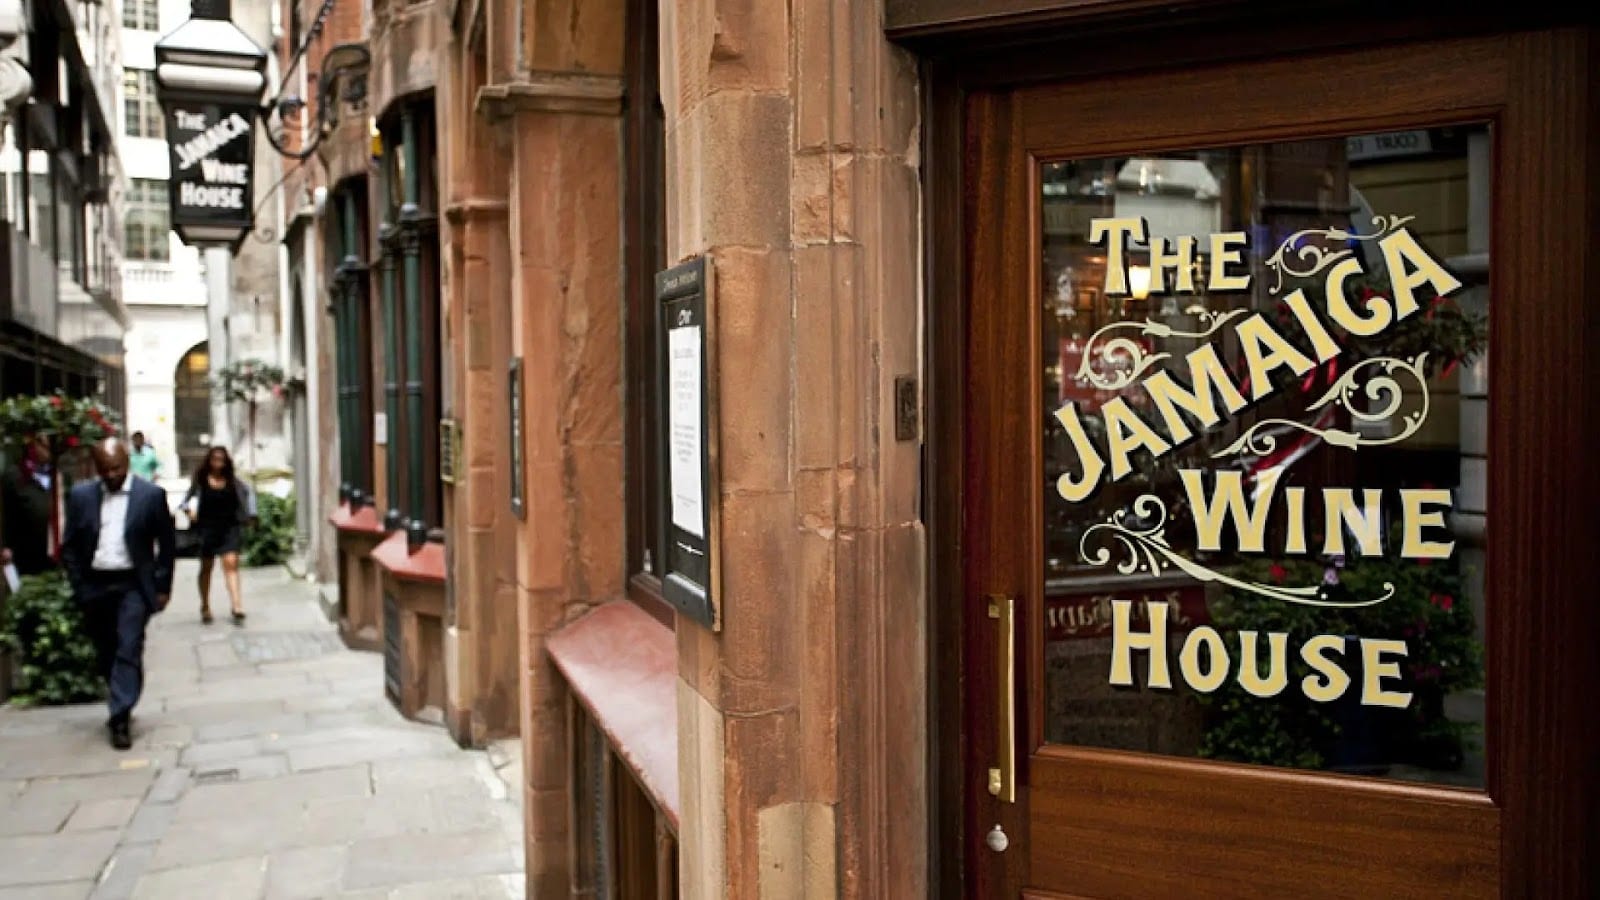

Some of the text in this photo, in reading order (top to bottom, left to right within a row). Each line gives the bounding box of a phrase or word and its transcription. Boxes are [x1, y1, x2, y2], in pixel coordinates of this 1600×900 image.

[175, 110, 206, 129] THE
[181, 181, 244, 208] HOUSE
[201, 159, 248, 184] WINE
[1089, 217, 1251, 295] THE
[1054, 228, 1462, 501] JAMAICA
[1179, 468, 1455, 560] WINE
[1109, 599, 1413, 708] HOUSE
